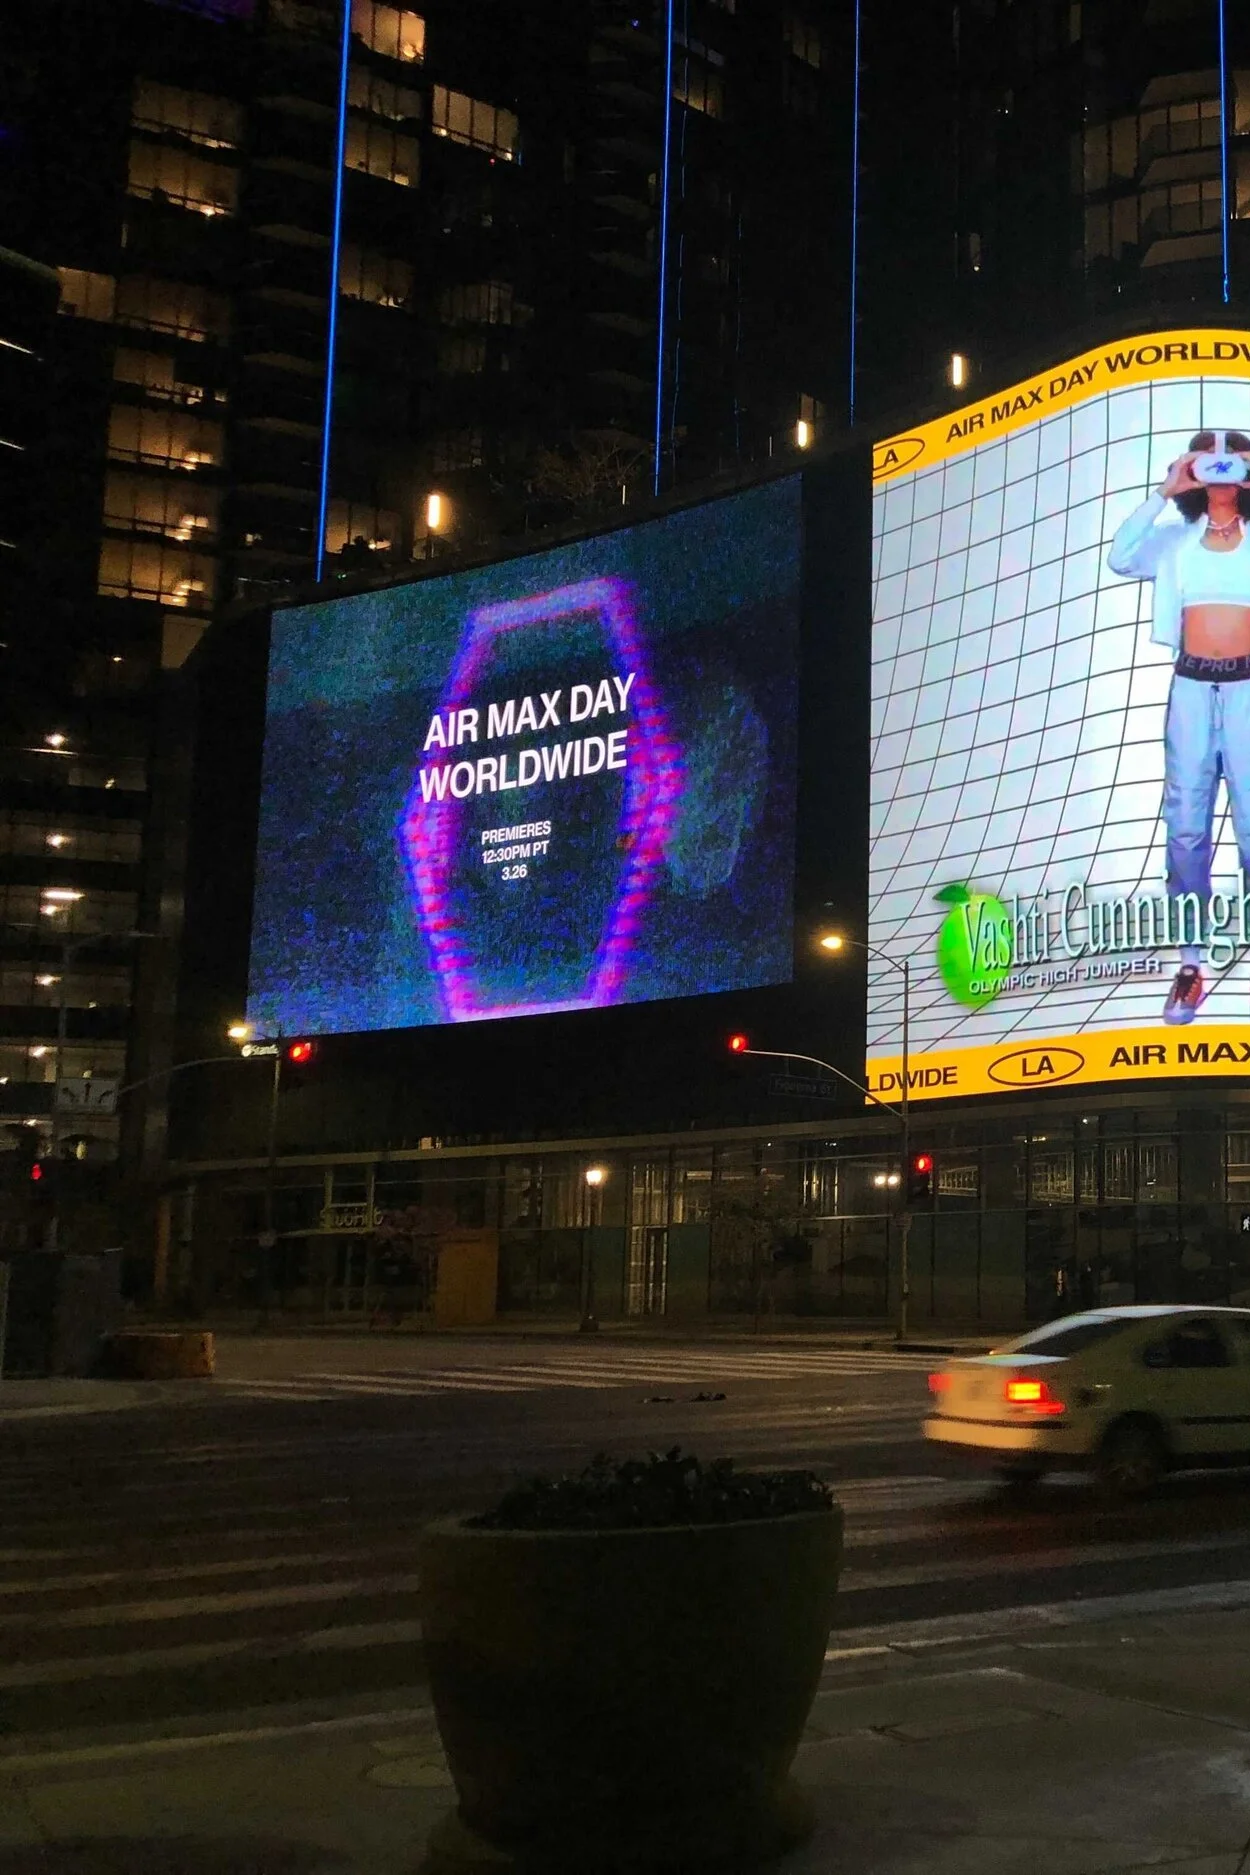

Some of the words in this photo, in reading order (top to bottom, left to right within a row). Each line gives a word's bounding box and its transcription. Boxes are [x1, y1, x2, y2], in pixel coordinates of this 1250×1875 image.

[946, 412, 985, 442] AIR
[991, 386, 1044, 422] MAX
[1049, 360, 1099, 398] DAY
[423, 708, 478, 751] AIR
[487, 689, 562, 740] MAX
[569, 672, 636, 723] DAY
[419, 729, 628, 803] WORLDWIDE
[481, 820, 551, 845] PREMIERES
[482, 843, 531, 864] 12:30PM
[532, 840, 550, 857] PT
[501, 864, 527, 880] 3.26
[961, 897, 1050, 973] Vashti
[969, 973, 1035, 995] OLYMPIC
[1039, 968, 1078, 986] HIGH
[1084, 958, 1162, 980] JUMPER
[1022, 1057, 1055, 1078] LA
[1110, 1046, 1166, 1067] AIR
